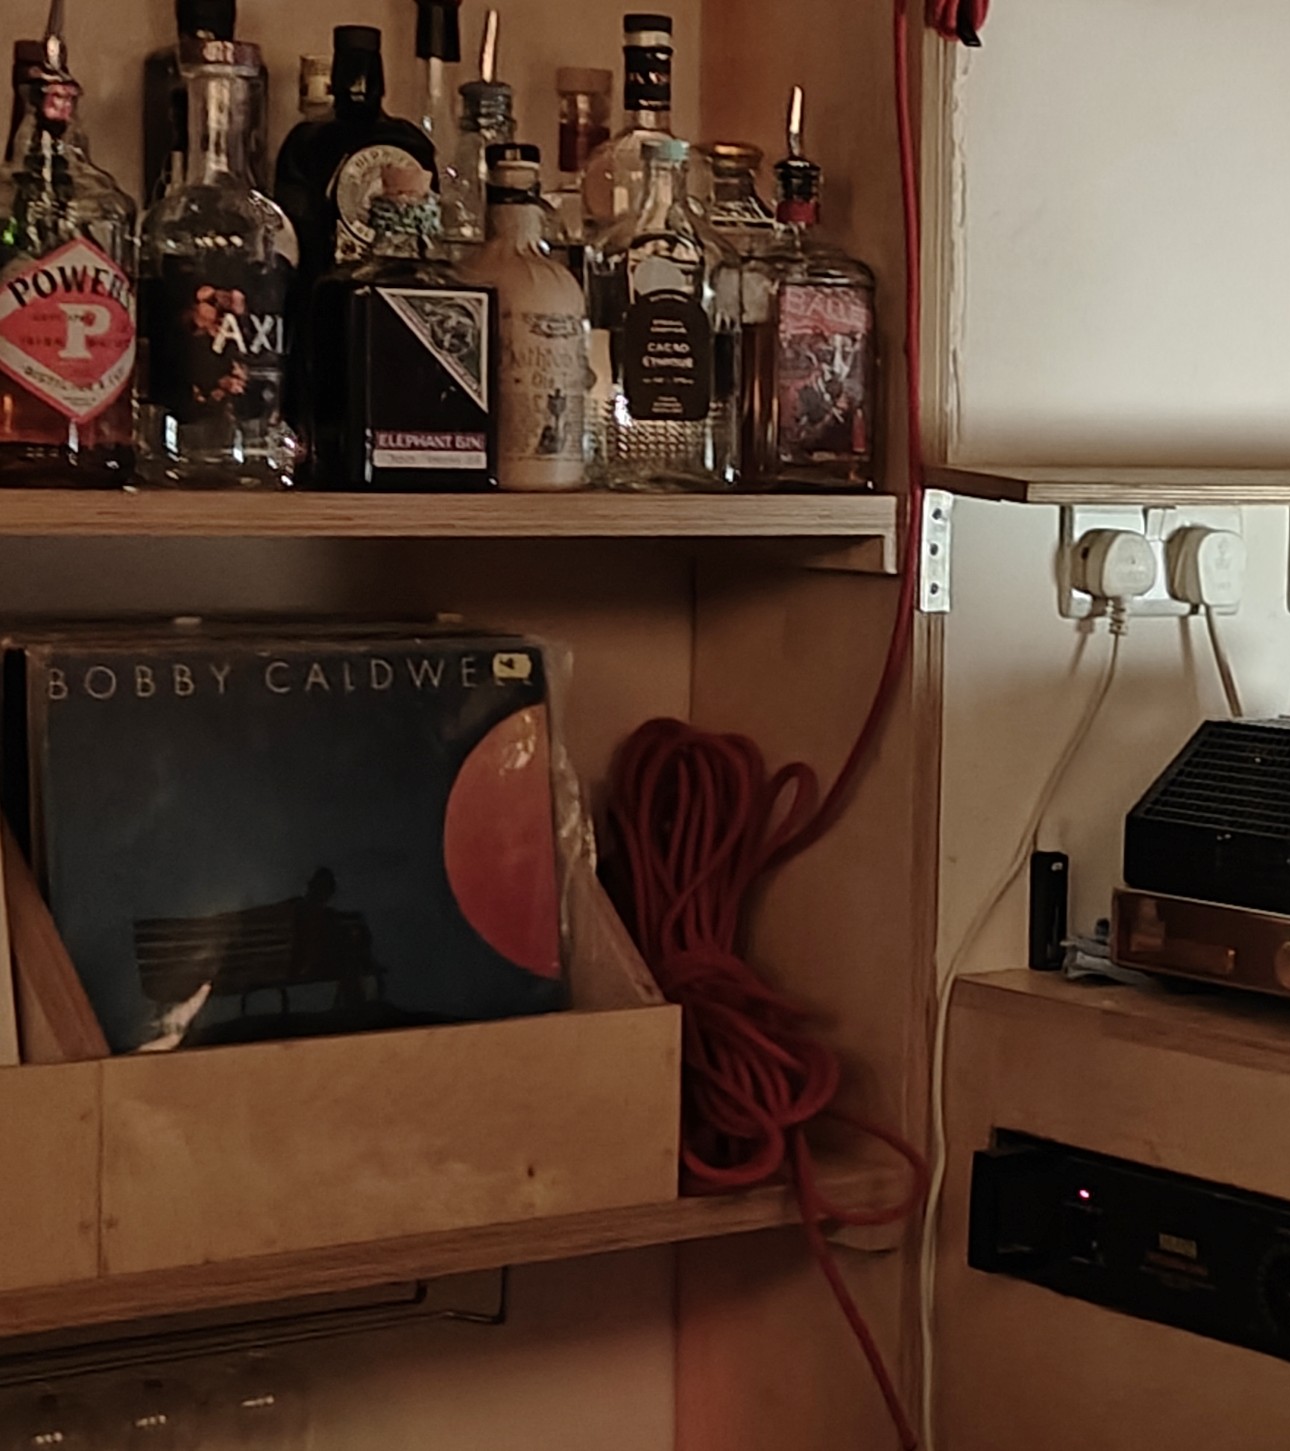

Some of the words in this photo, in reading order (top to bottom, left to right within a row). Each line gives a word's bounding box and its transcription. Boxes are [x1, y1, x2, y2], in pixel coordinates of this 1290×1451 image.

[57, 303, 111, 359] P
[379, 433, 453, 449] ELEPHANT
[48, 663, 230, 700] BOBBY
[265, 657, 532, 693] CALDWE
